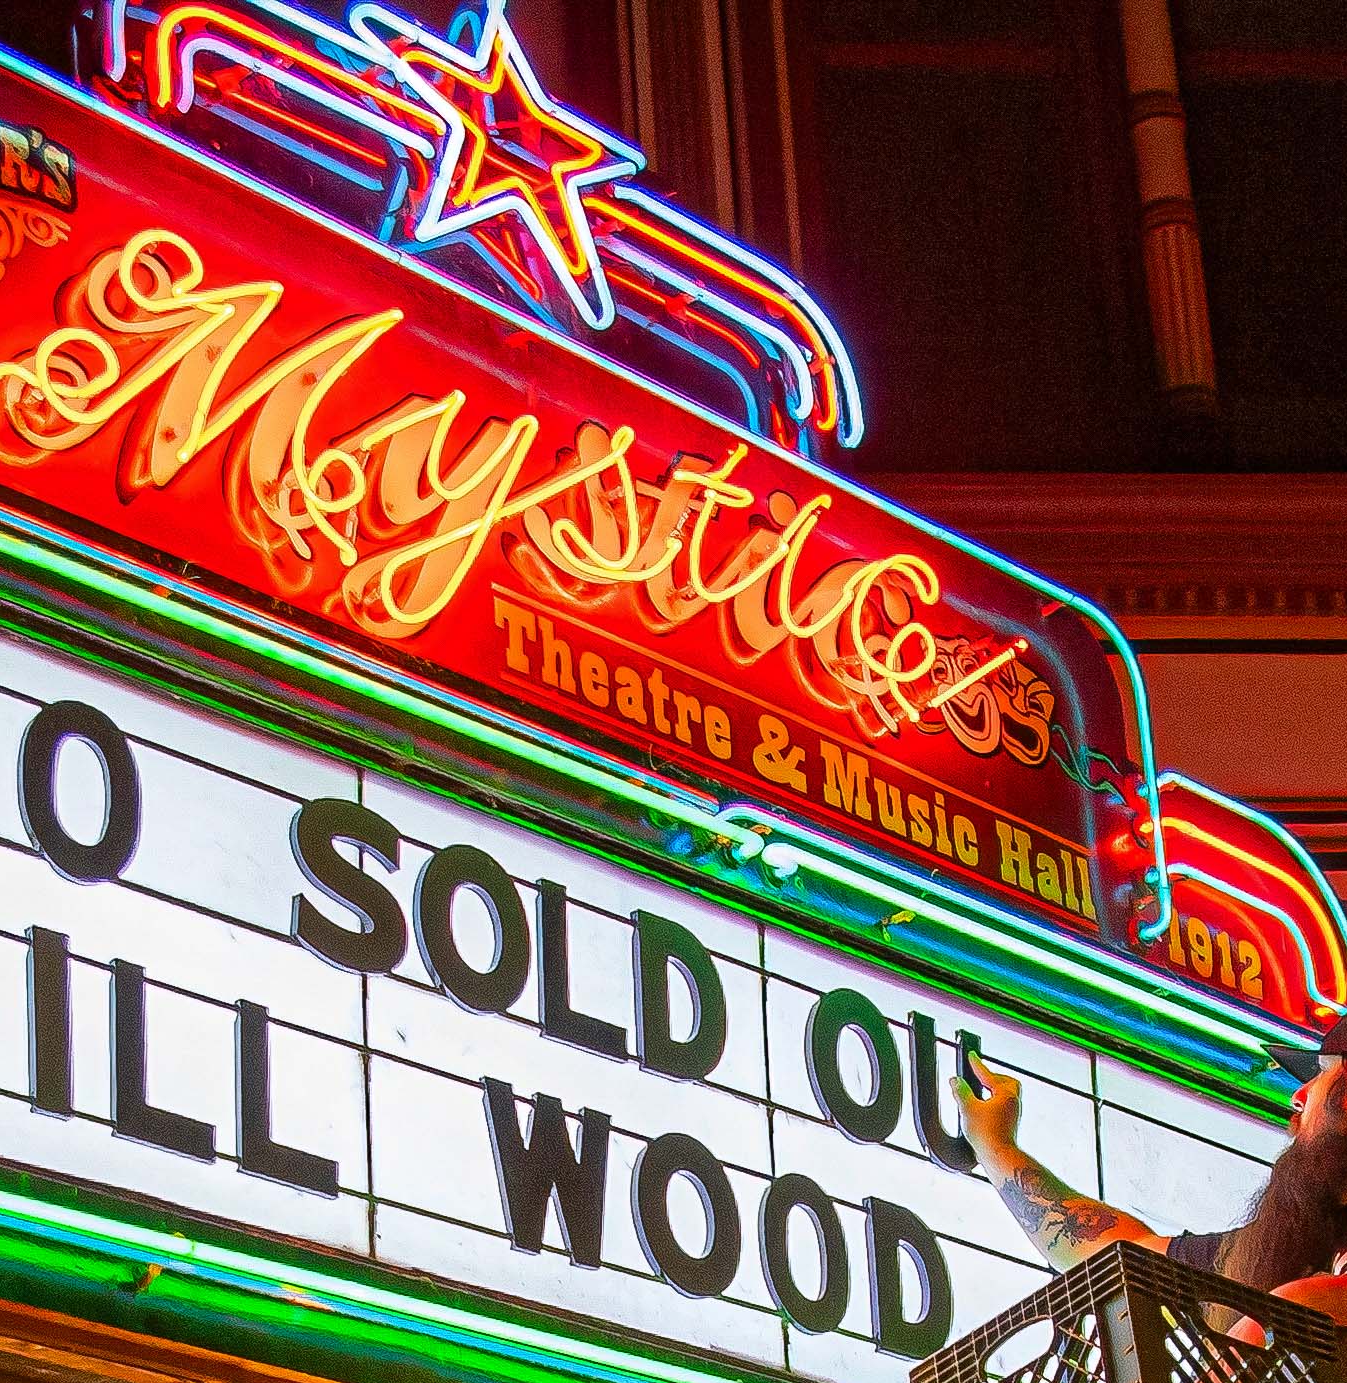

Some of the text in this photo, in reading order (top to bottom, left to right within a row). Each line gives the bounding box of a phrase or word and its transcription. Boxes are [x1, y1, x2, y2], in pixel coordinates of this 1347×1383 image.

[494, 597, 1097, 921] Theatre & Music Hall
[290, 798, 727, 1084] SOLD
[805, 987, 986, 1173] OU
[1168, 908, 1264, 1000] 1912
[480, 1076, 954, 1361] WOOD
